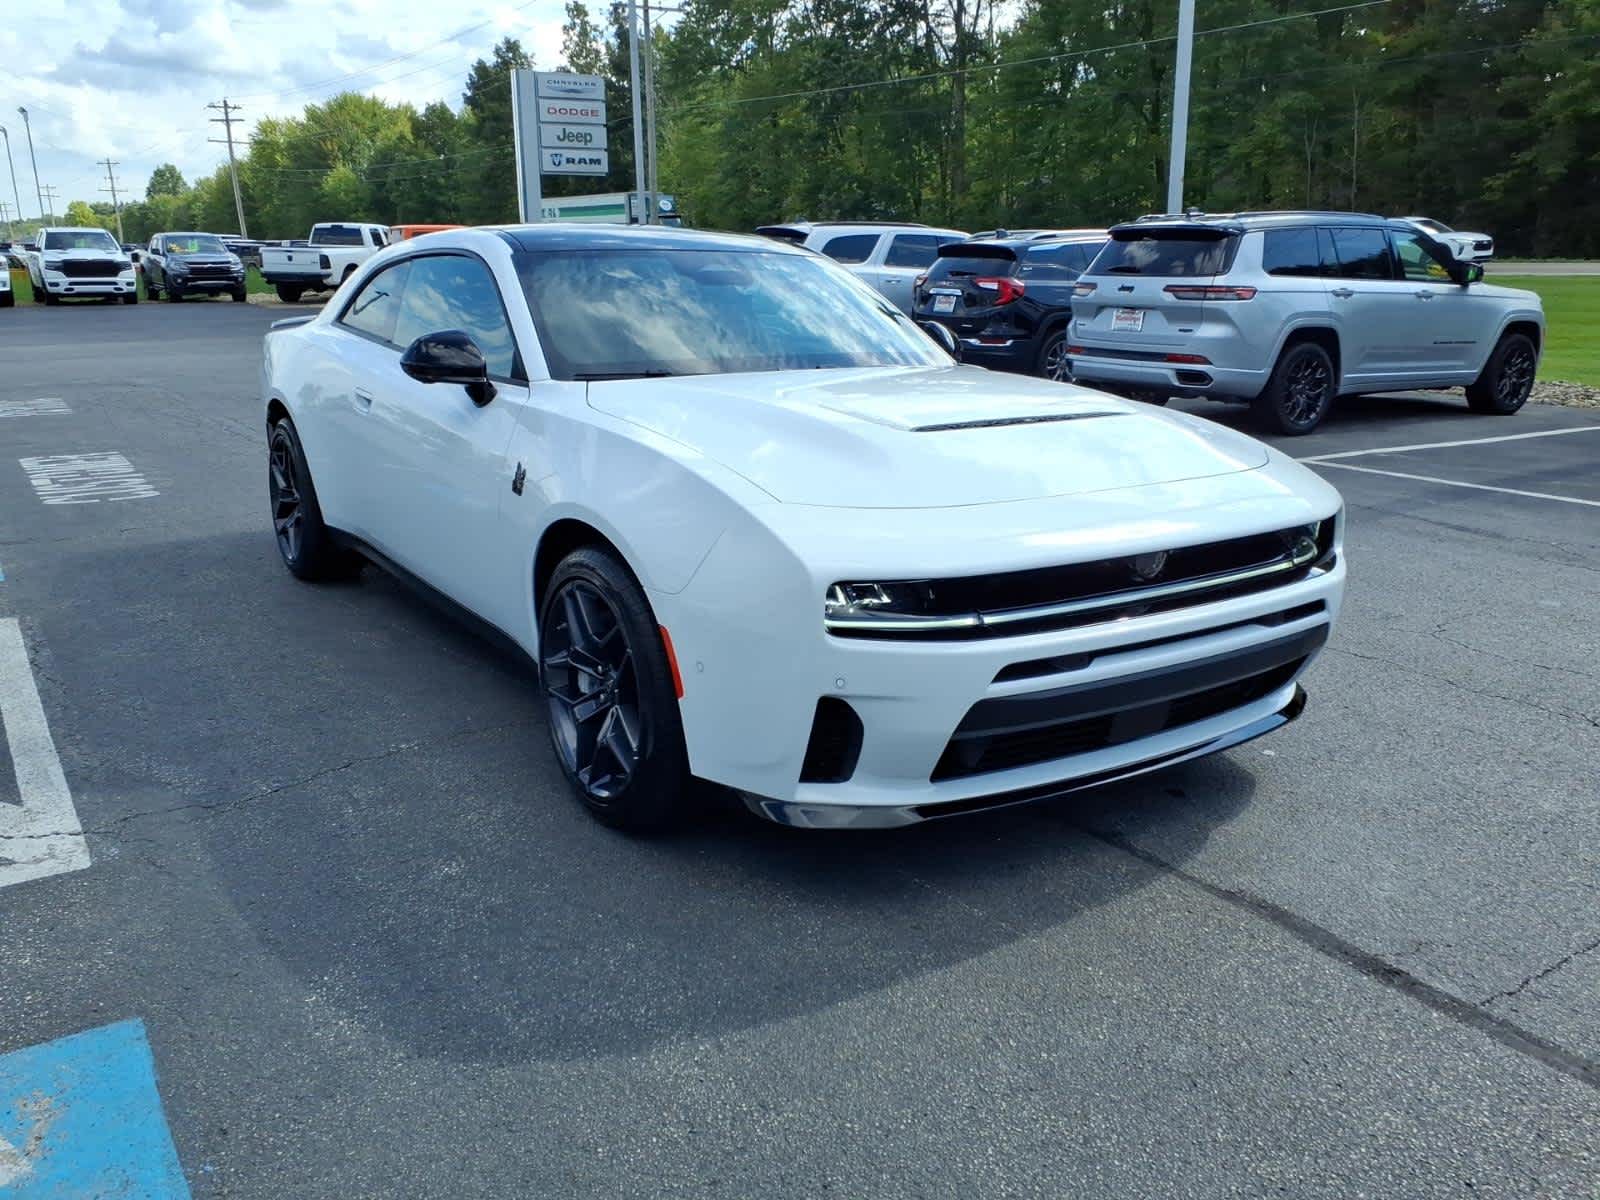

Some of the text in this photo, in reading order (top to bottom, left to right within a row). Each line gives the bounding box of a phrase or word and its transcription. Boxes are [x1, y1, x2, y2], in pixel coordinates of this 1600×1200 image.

[547, 79, 597, 87] CHRYSLER
[547, 106, 601, 117] DODGE
[556, 127, 593, 146] Jeep
[565, 157, 602, 166] RAM
